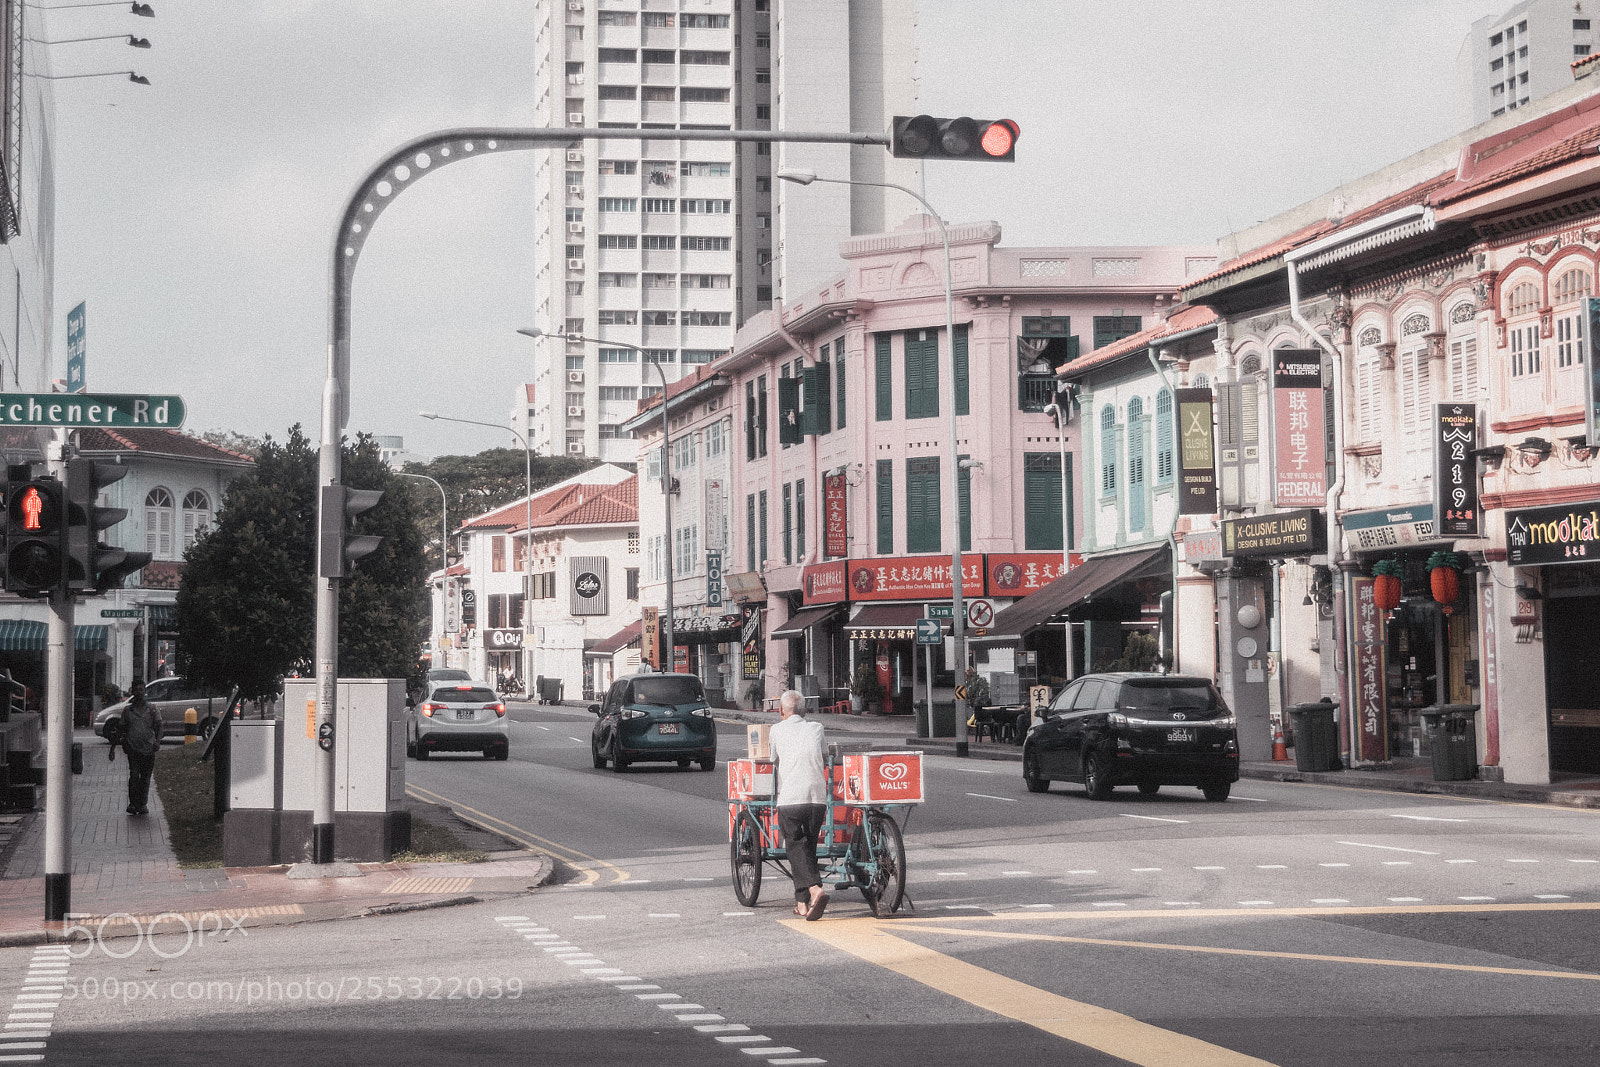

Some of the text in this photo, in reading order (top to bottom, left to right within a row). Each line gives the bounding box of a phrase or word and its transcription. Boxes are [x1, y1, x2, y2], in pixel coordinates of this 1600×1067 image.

[134, 399, 169, 424] Rd
[1288, 391, 1309, 470] 联邦电子
[1186, 449, 1209, 461] LIVING
[1451, 440, 1466, 508] 219
[1277, 481, 1325, 497] FEDERAL
[1236, 517, 1307, 538] X-CLUSIVE LIVING
[1238, 540, 1258, 549] DESIGN
[1265, 537, 1282, 546] BUILD
[1283, 535, 1294, 544] PTE
[1295, 533, 1307, 543] LTD
[1510, 532, 1527, 546] THAI
[709, 557, 721, 604] TOTO
[930, 608, 949, 616] Sam
[1518, 602, 1532, 614] 219
[1483, 588, 1495, 684] SALE
[879, 781, 908, 790] WALL'S
